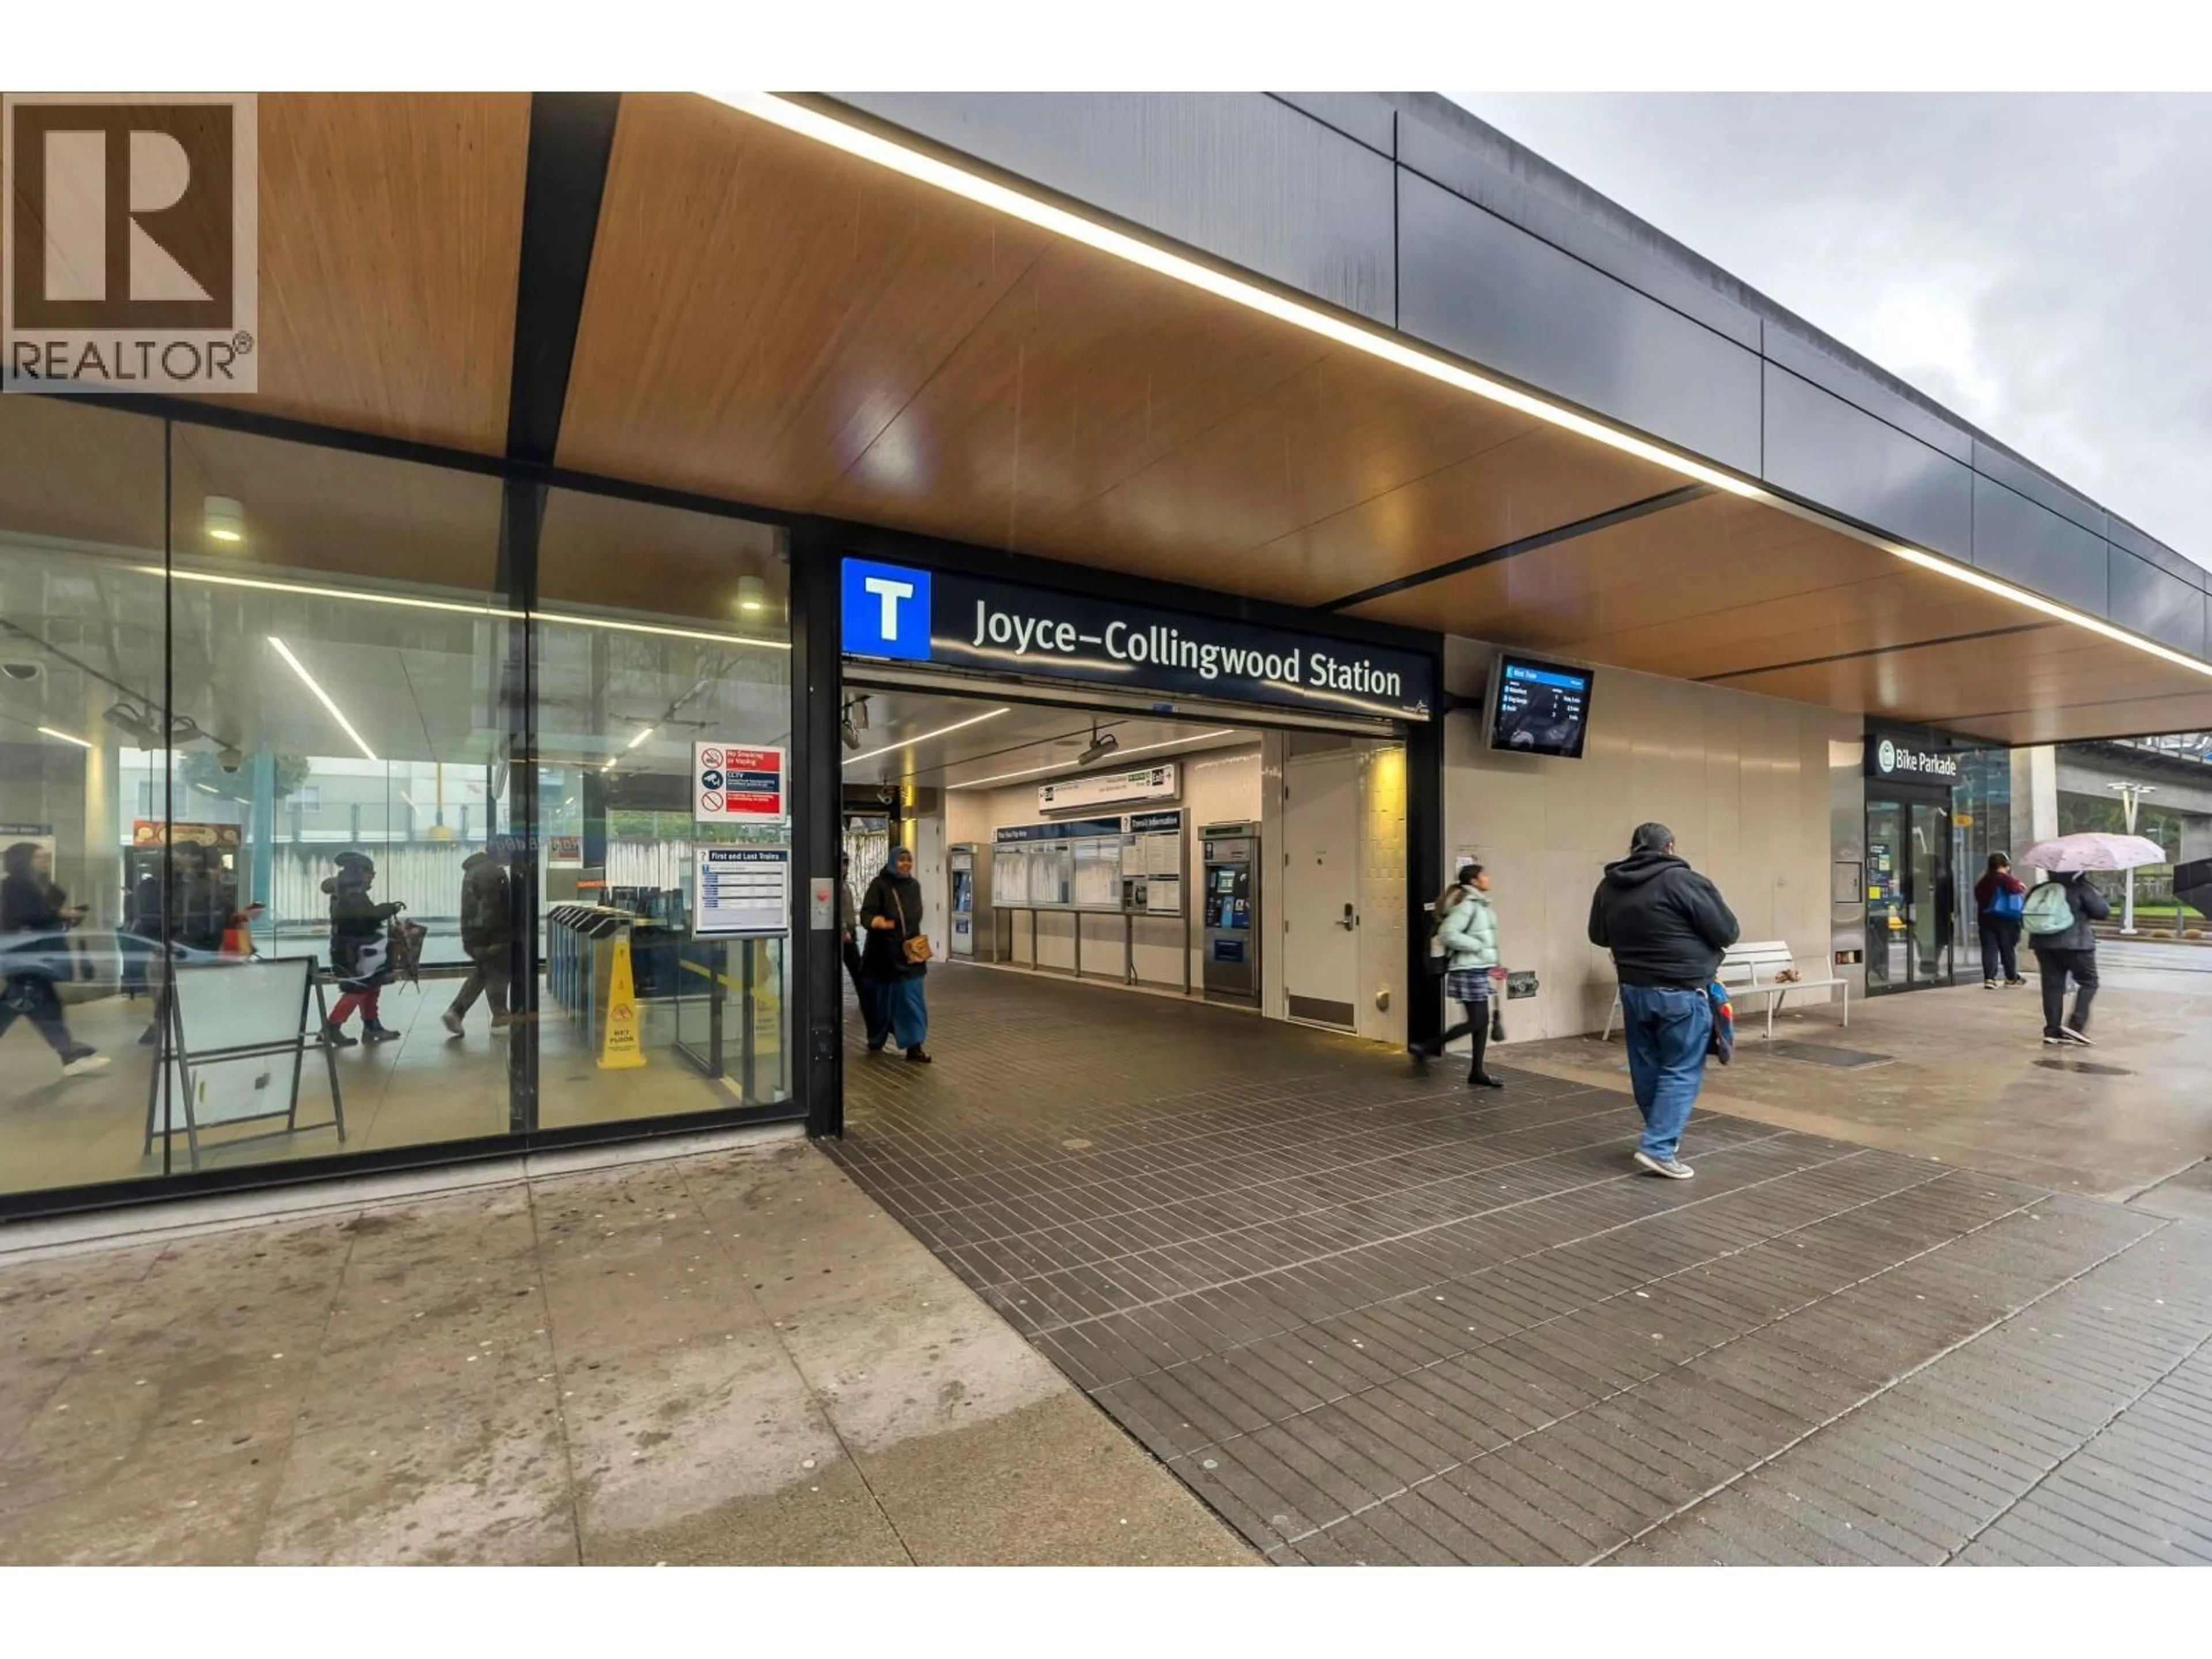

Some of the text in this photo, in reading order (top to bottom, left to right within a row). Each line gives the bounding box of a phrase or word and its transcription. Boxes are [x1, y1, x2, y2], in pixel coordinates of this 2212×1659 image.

[865, 577, 914, 641] T
[1310, 653, 1400, 696] Station
[1896, 749, 1957, 776] Bike Parkade
